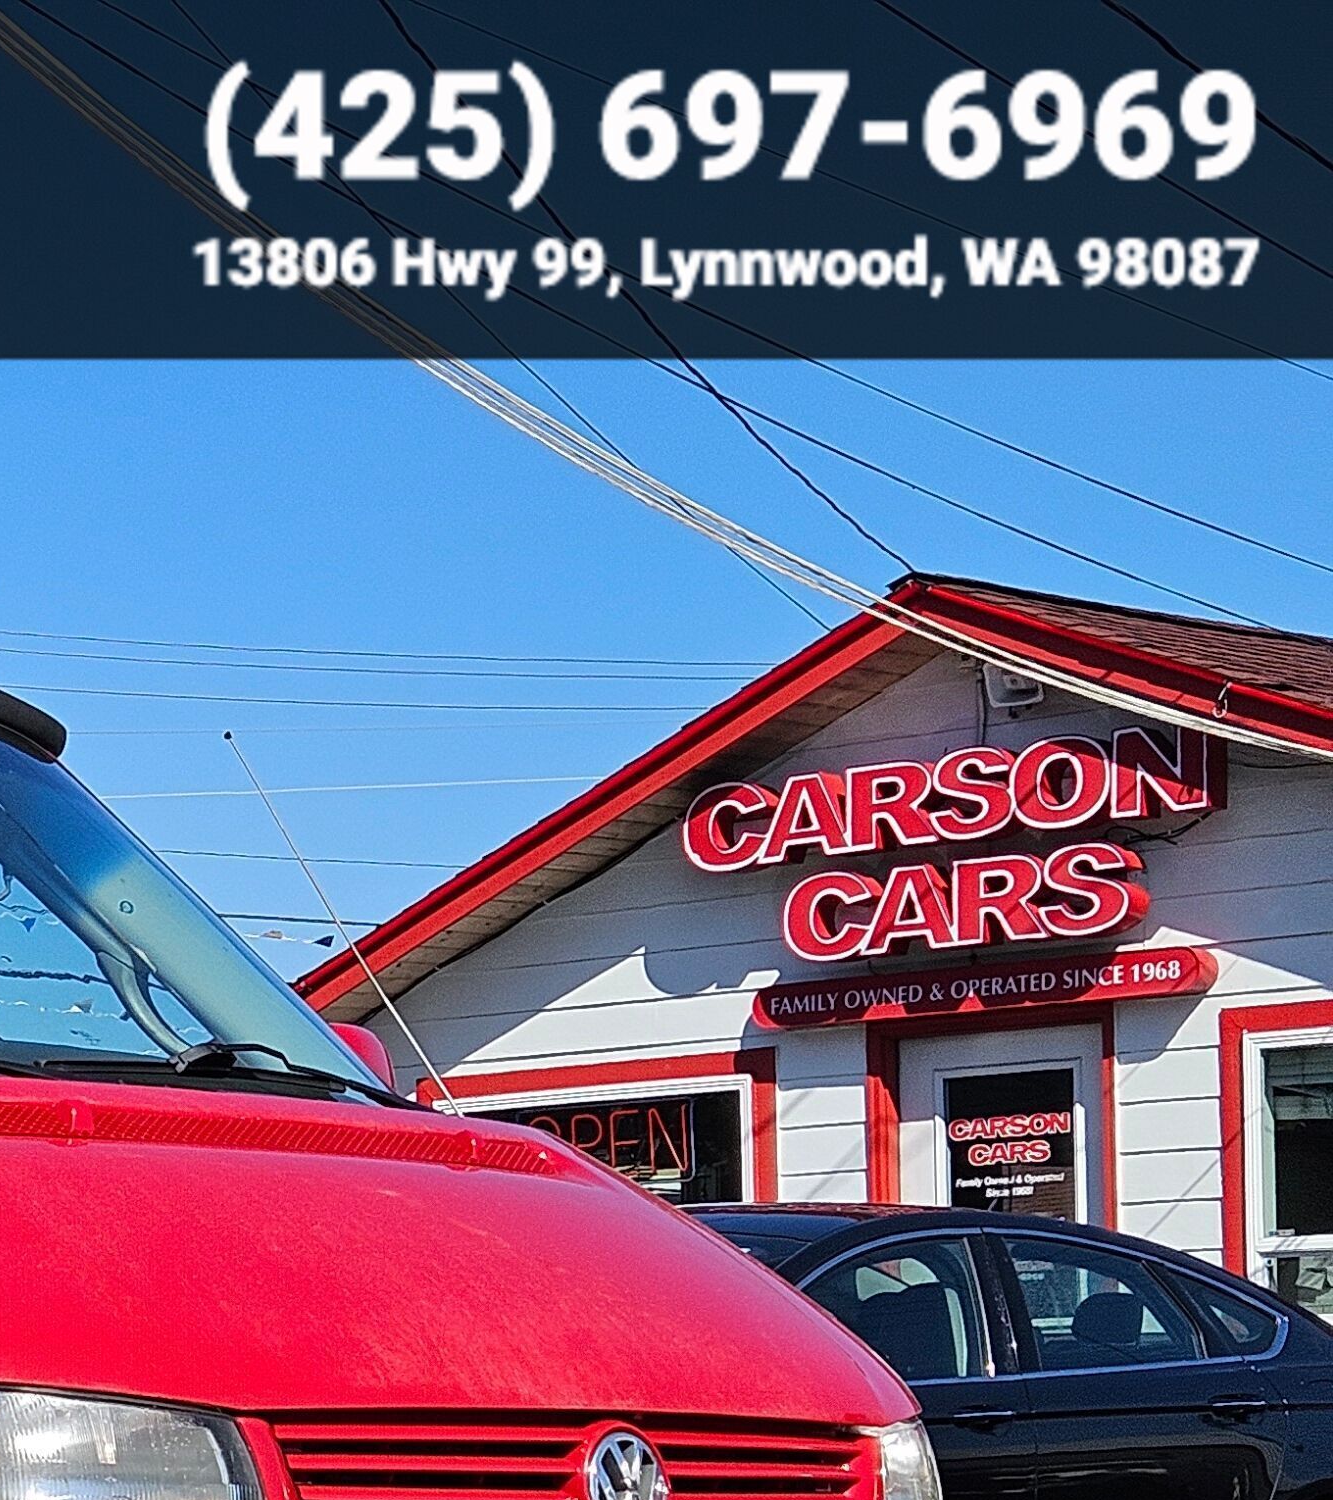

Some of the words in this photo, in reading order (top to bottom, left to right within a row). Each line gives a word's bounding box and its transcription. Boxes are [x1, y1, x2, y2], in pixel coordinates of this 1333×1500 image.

[682, 726, 1211, 873] CARSON
[782, 842, 1133, 962] CARS
[770, 992, 839, 1015] FAMILY
[844, 984, 918, 1008] OWNED
[931, 983, 945, 1001] &
[950, 970, 1057, 998] OPERATED
[1062, 965, 1124, 990] SINCE
[1129, 960, 1181, 982] 1968
[949, 1112, 1071, 1141] CARSON
[968, 1140, 1051, 1166] CARS
